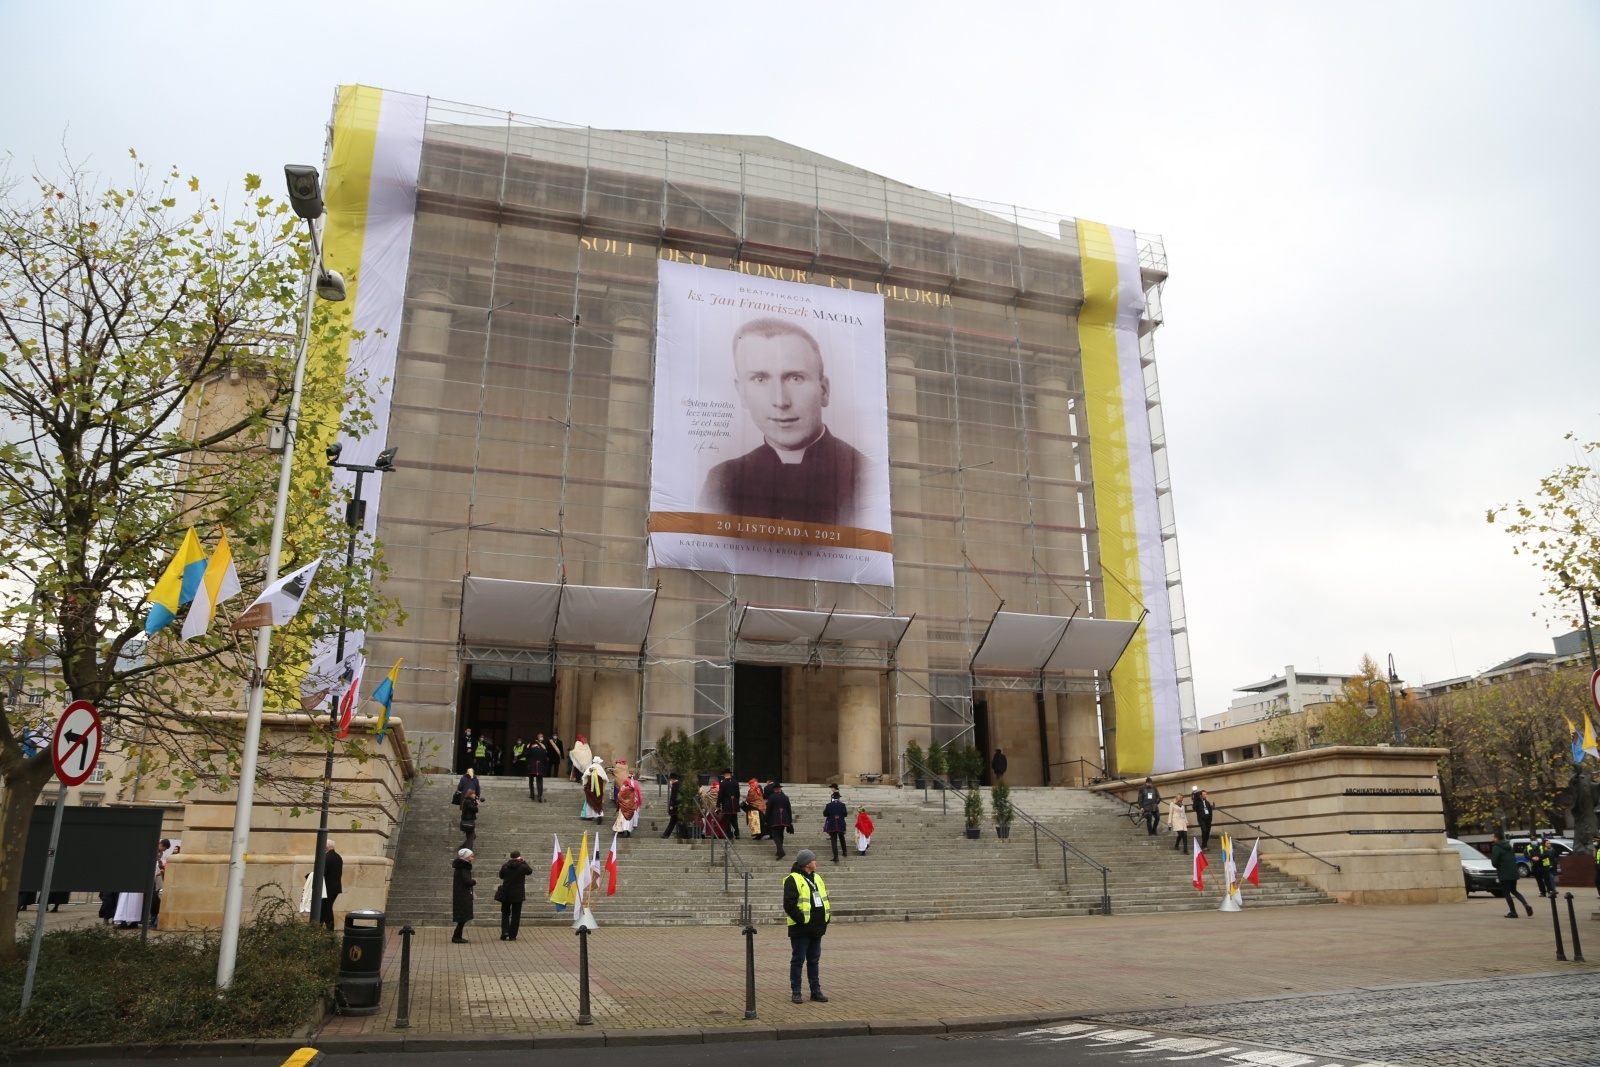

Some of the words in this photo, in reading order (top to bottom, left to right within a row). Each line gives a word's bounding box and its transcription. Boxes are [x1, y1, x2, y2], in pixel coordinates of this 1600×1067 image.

[739, 286, 811, 303] BEATYFIKACJA
[687, 289, 704, 302] ks.
[709, 293, 735, 306] Jan
[739, 298, 808, 318] Franciszek
[812, 308, 863, 326] MACHA
[716, 520, 731, 531] 20
[737, 522, 809, 538] LISTOPADA
[815, 530, 842, 541] 2021
[679, 539, 719, 549] KATEDRA
[723, 543, 772, 553] CHRYSTUSA
[816, 551, 870, 562] KATOWICACH
